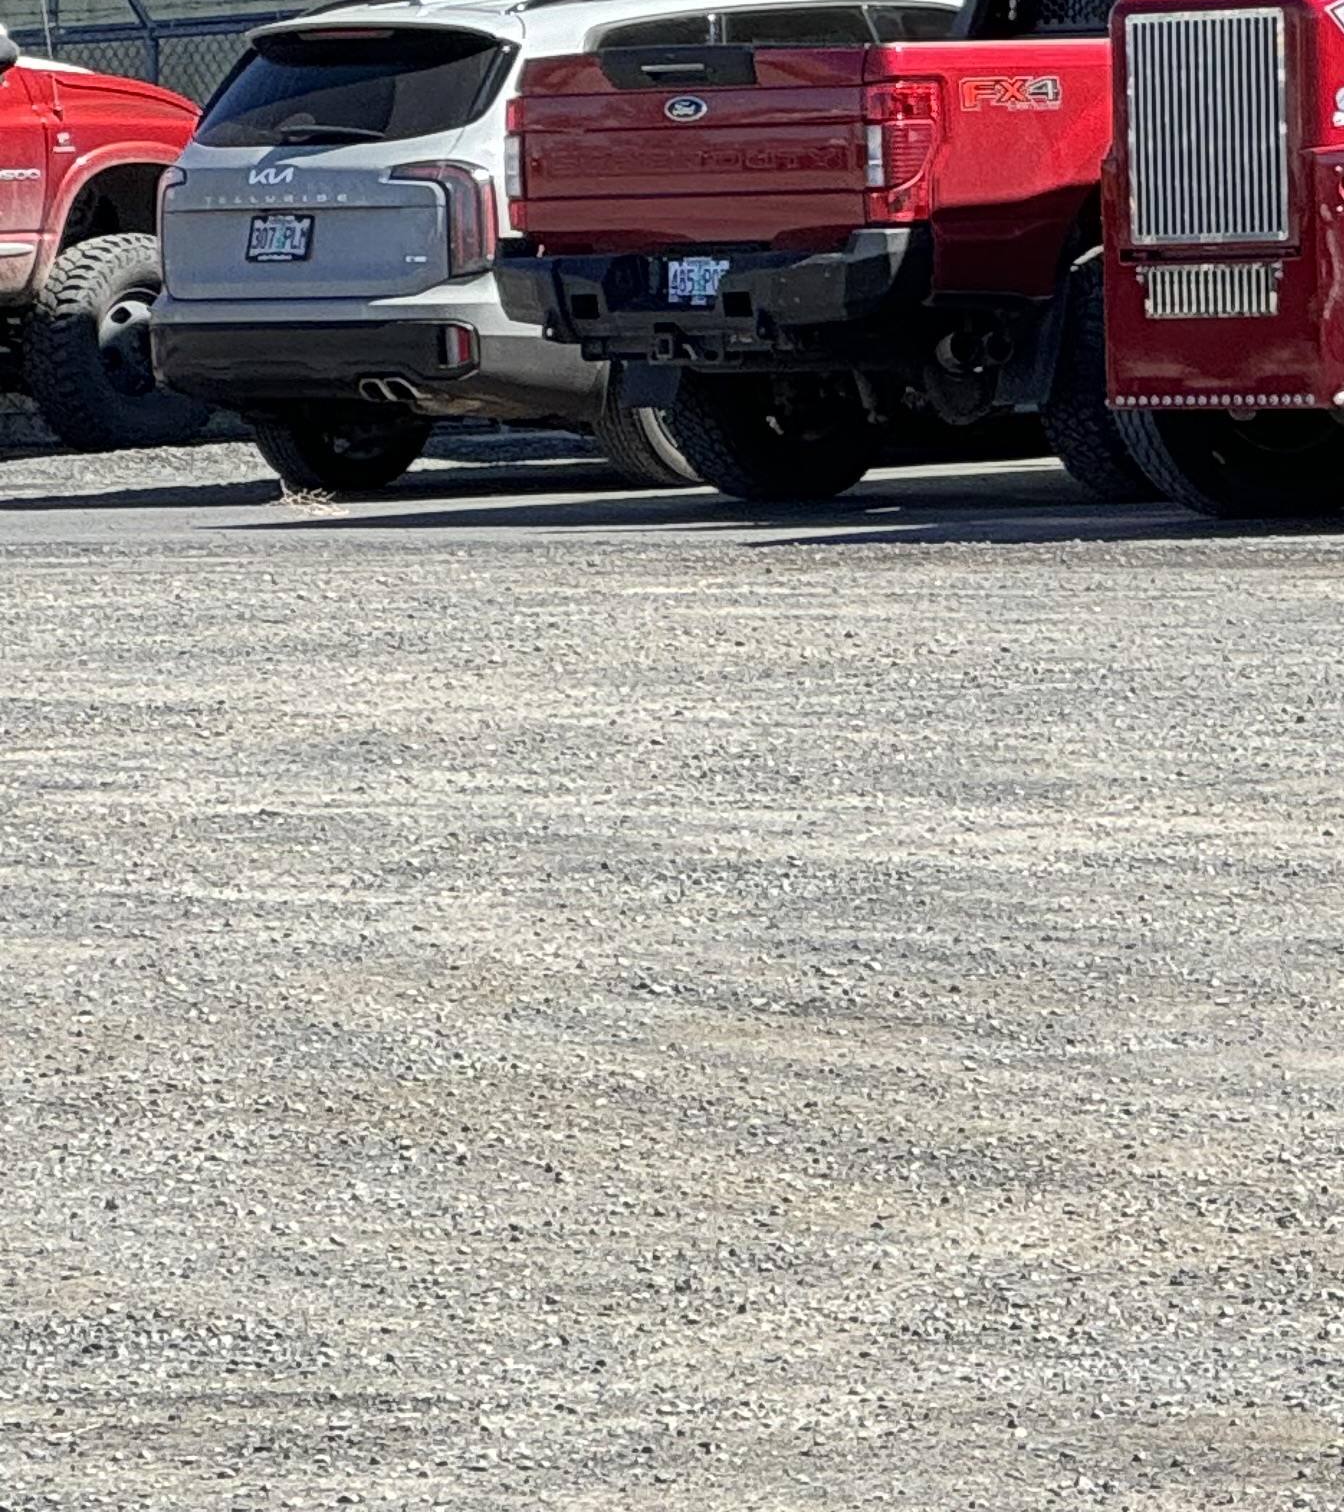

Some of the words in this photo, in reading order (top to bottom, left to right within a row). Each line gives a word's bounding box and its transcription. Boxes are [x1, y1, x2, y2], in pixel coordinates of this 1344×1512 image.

[959, 76, 1061, 111] FX4
[249, 167, 294, 184] KIA
[205, 194, 347, 205] TELLURIDE
